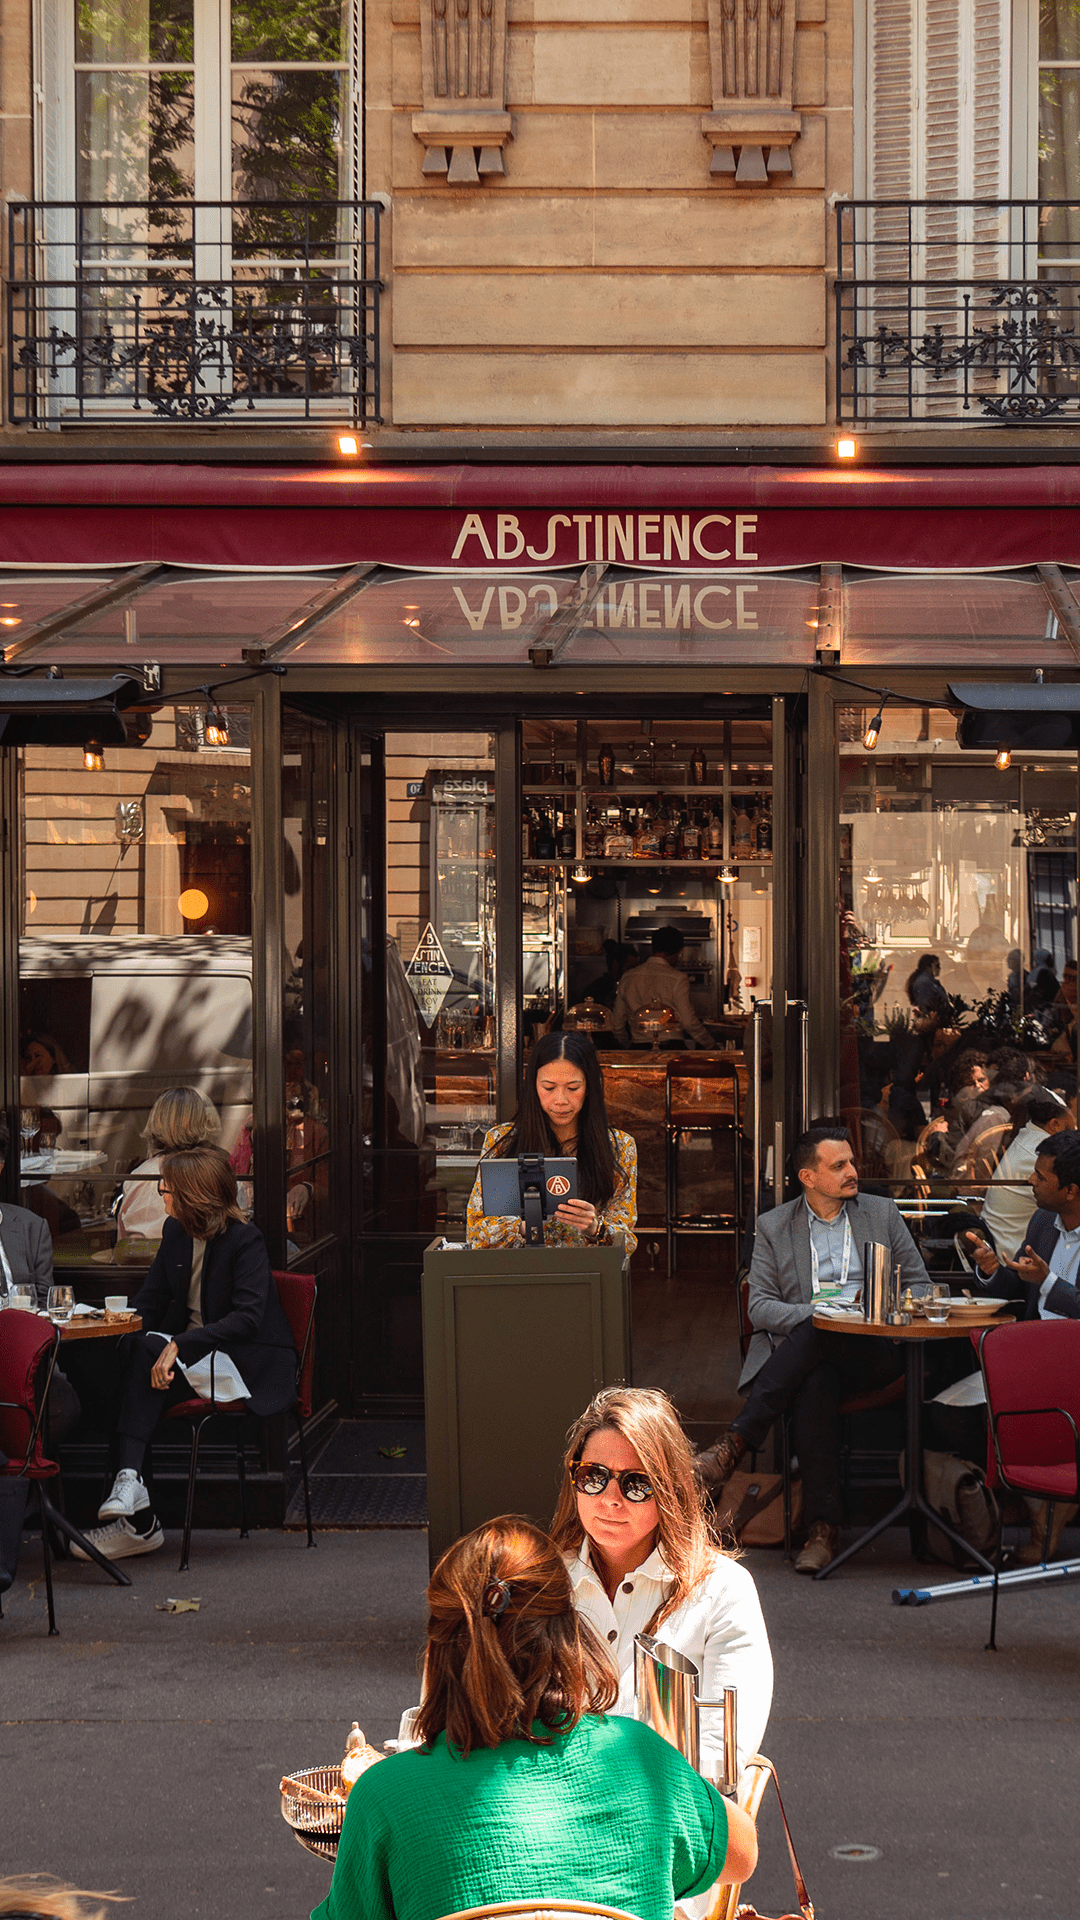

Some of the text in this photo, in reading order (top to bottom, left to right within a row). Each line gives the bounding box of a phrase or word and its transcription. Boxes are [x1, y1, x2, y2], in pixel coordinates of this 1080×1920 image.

[451, 514, 759, 561] ABSTINENCE
[415, 949, 440, 961] STIN
[414, 961, 445, 974] ENCE
[417, 988, 442, 996] DRINK
